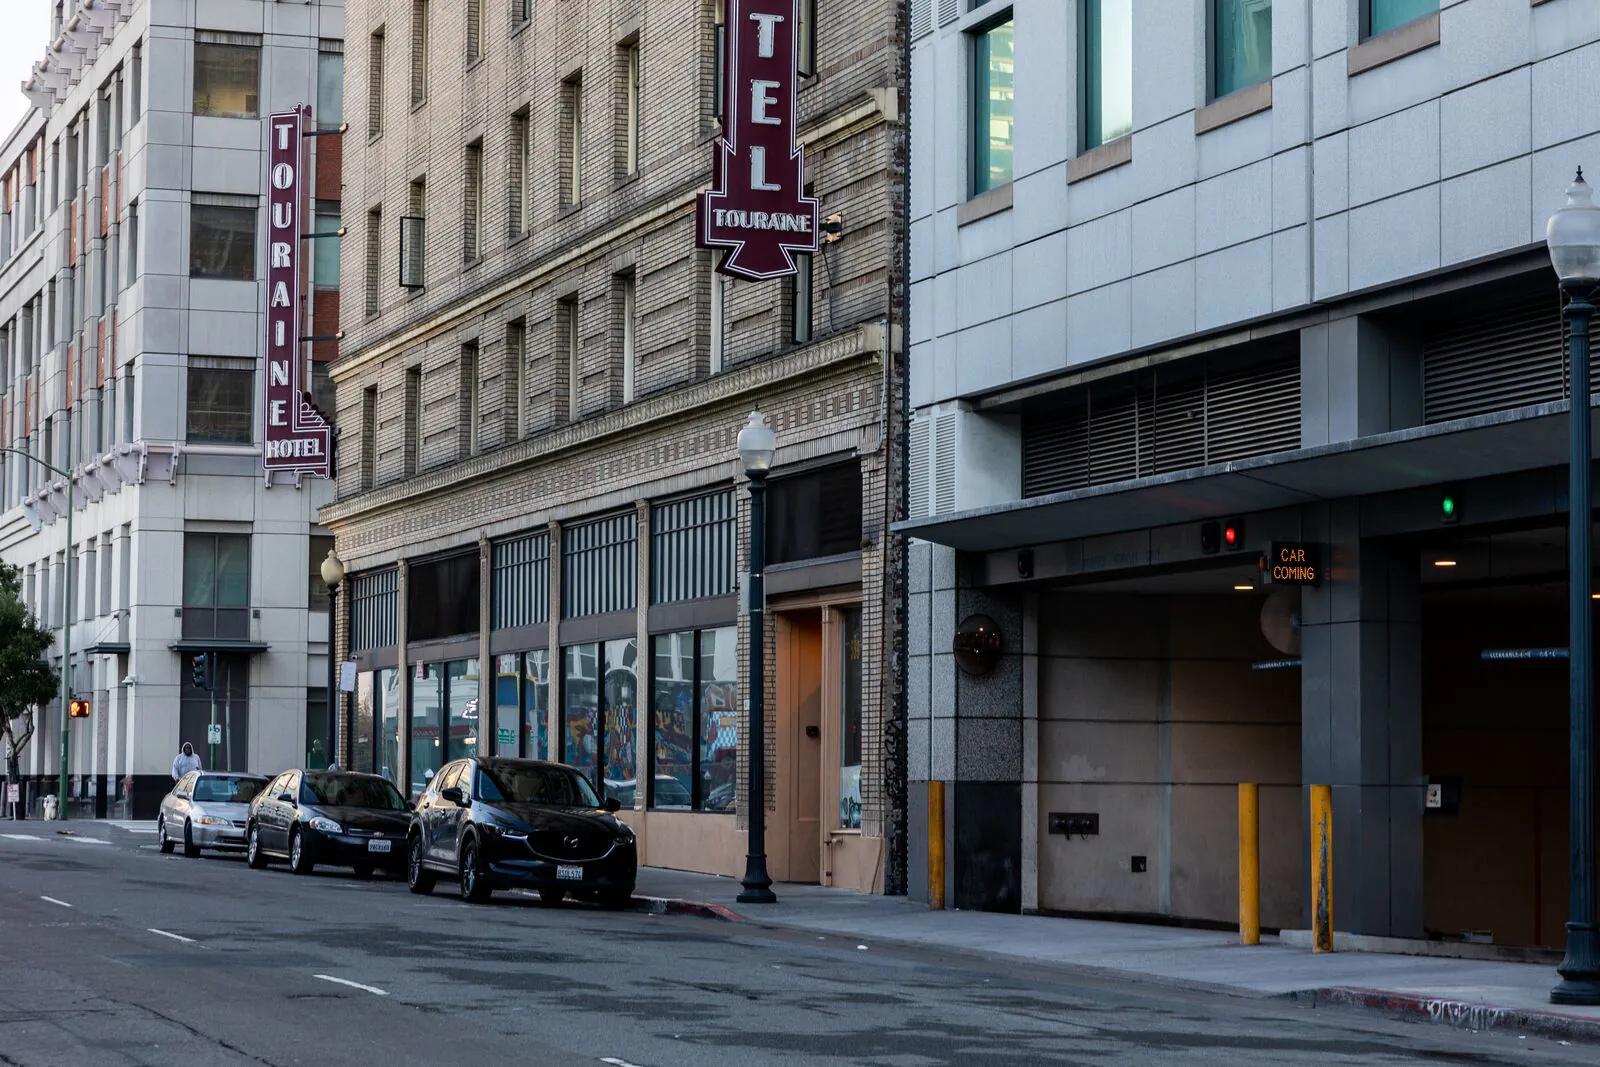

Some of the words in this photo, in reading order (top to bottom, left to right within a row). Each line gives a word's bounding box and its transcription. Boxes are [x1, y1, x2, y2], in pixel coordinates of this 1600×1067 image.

[714, 208, 812, 233] TOURAINE
[269, 123, 294, 427] TOURAINE
[266, 437, 325, 459] HOTEL
[1280, 548, 1306, 563] CAR
[1273, 566, 1315, 581] COMING
